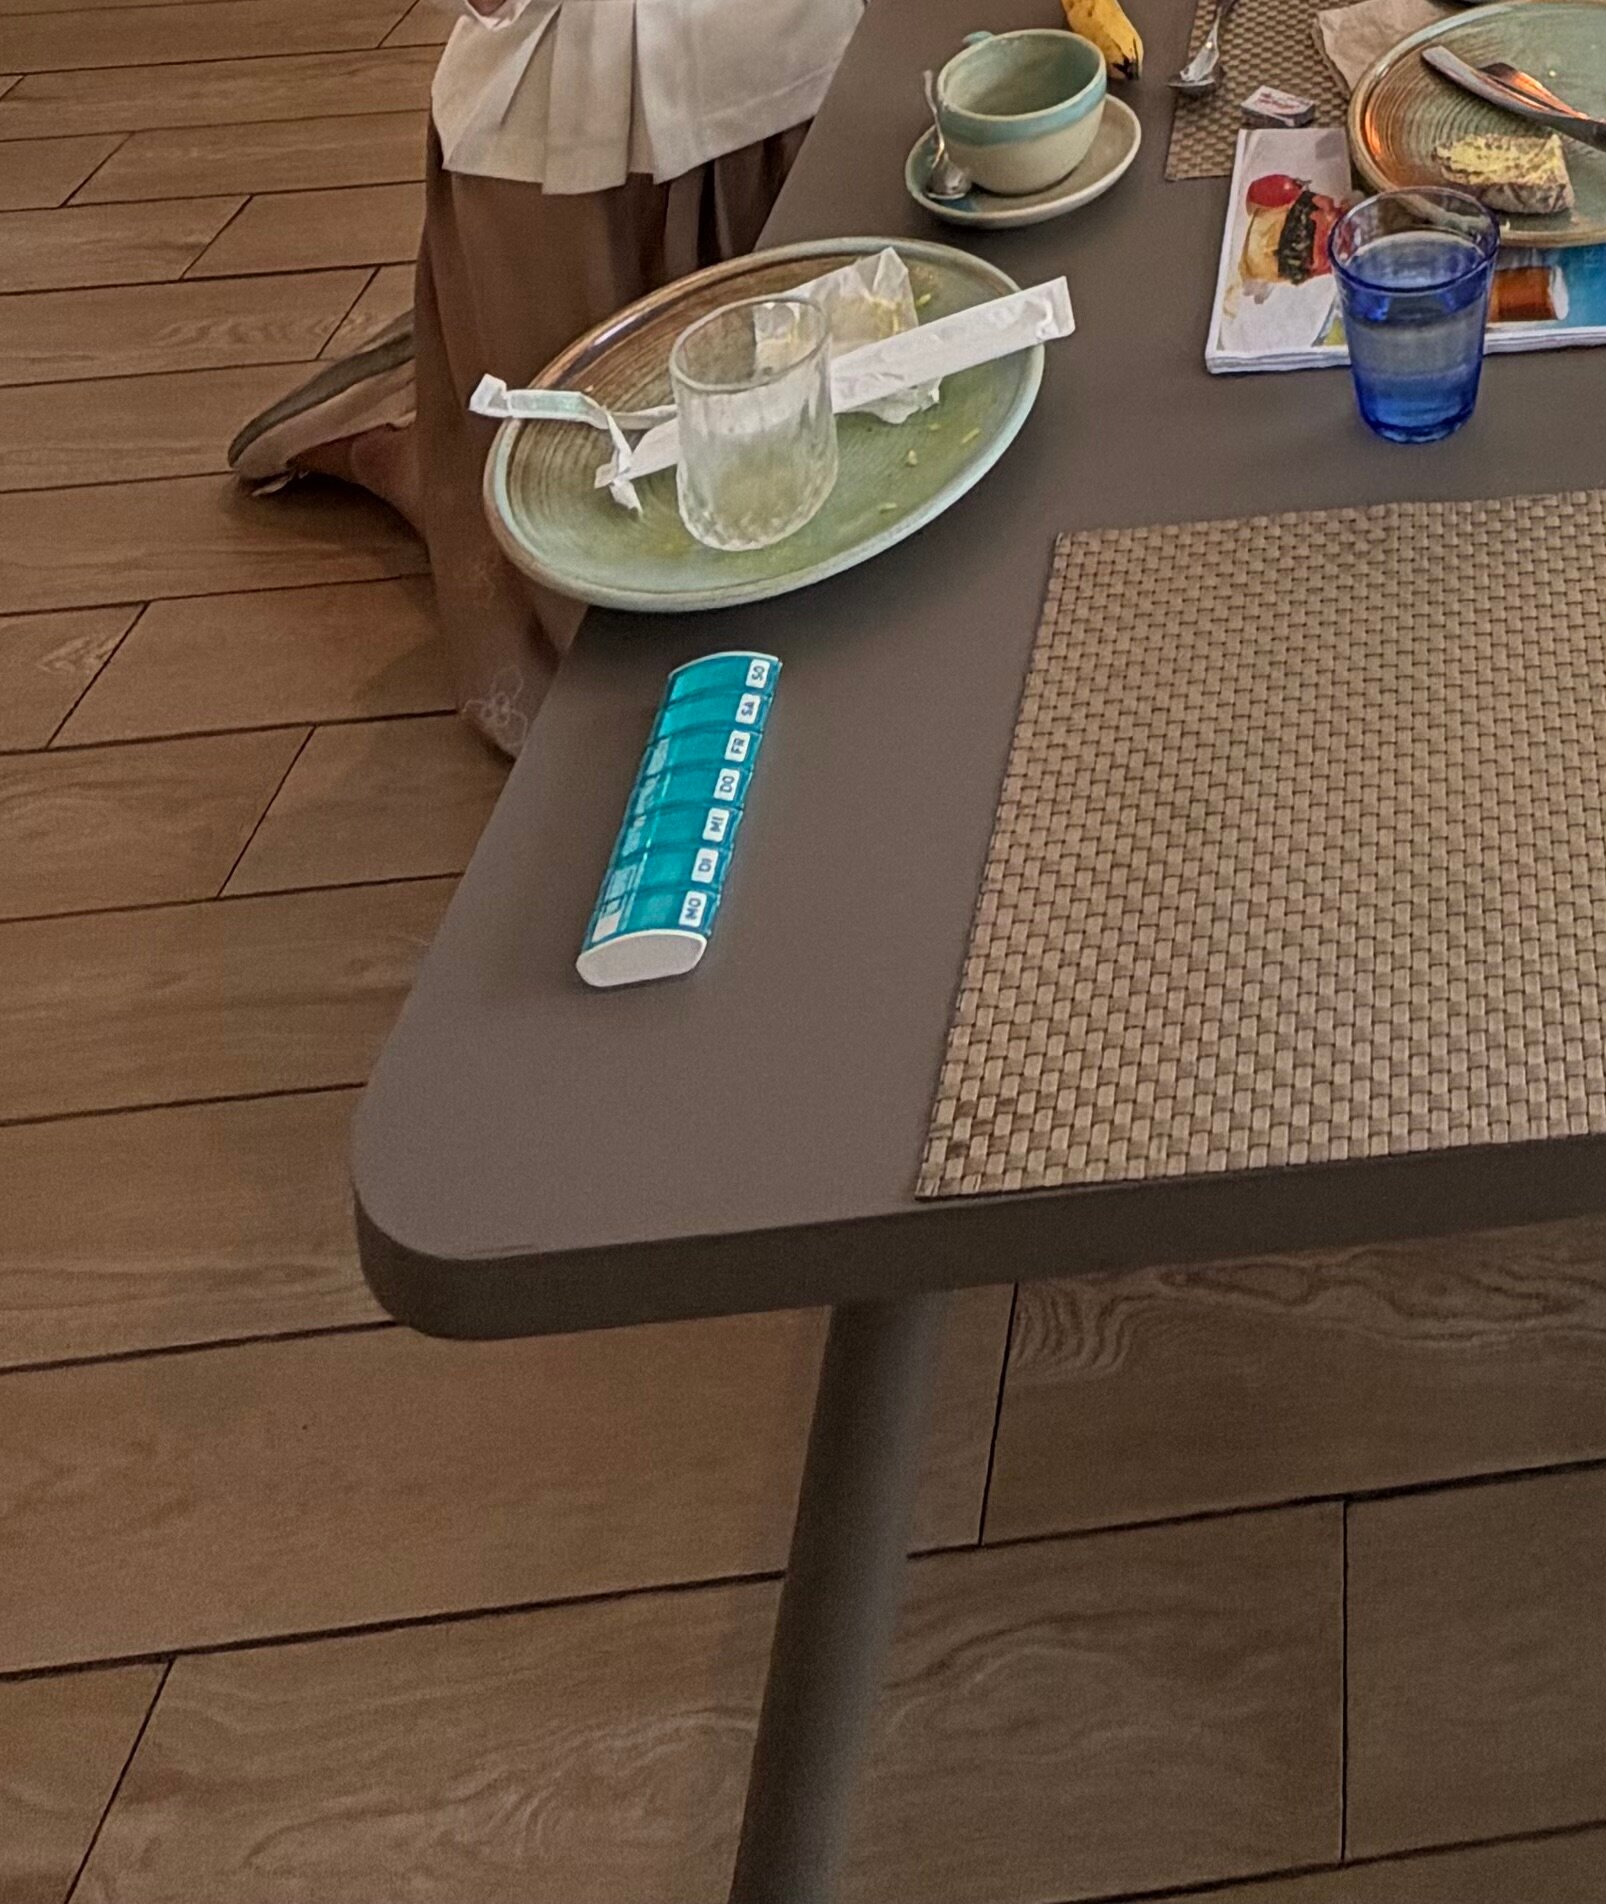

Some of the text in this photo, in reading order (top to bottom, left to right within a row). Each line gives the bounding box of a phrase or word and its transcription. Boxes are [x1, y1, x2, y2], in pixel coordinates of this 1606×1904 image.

[751, 665, 765, 681] SO
[741, 701, 755, 717] SA
[730, 737, 745, 754] FR
[719, 775, 735, 793] DO
[709, 816, 724, 833] MI
[698, 858, 712, 872] DI
[685, 897, 702, 920] MO
